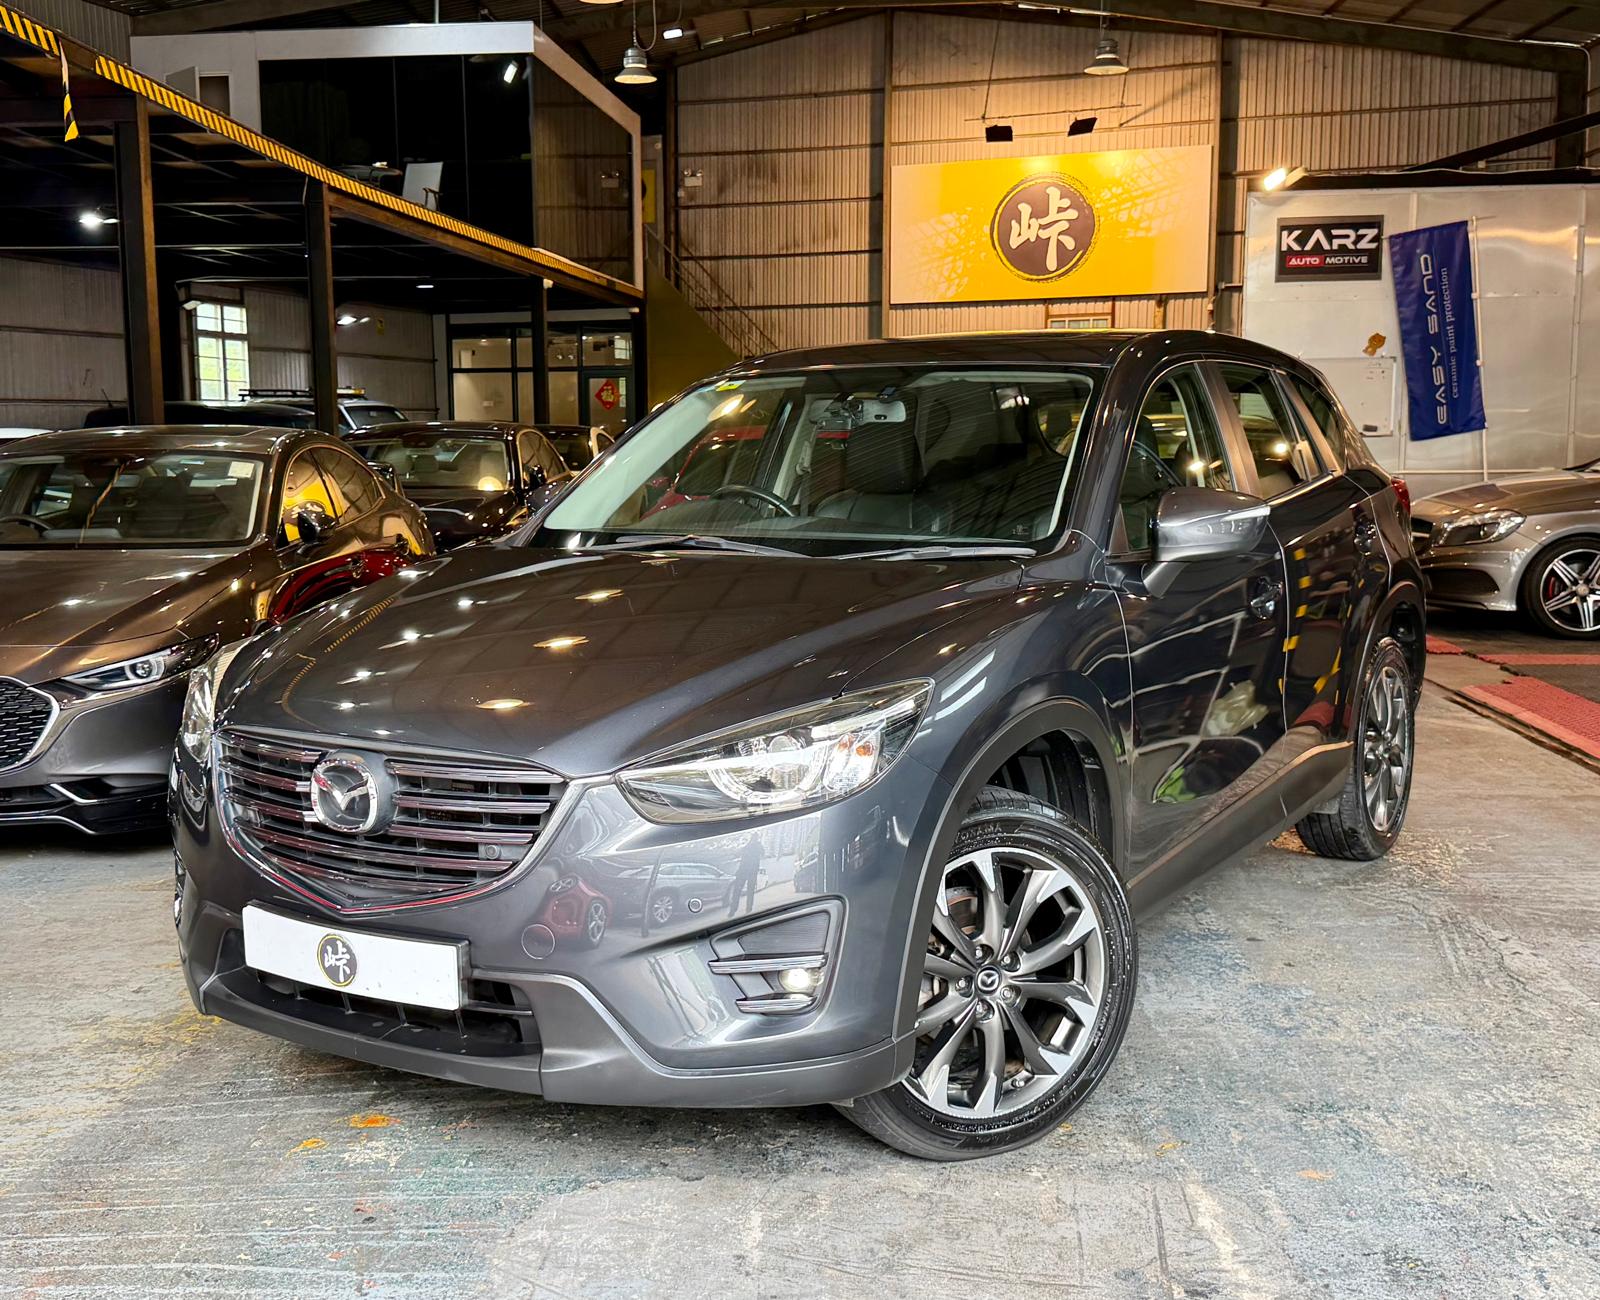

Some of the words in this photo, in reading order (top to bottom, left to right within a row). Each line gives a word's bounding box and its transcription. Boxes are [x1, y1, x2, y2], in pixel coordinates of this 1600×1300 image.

[1281, 228, 1379, 251] KARZ
[1289, 257, 1320, 266] AUTO
[1325, 255, 1368, 265] MOTIVE
[1420, 254, 1439, 335] SAND
[1440, 267, 1455, 323] protection
[1446, 324, 1457, 354] paint
[1430, 345, 1447, 424] EASY
[1449, 355, 1459, 399] ceramic
